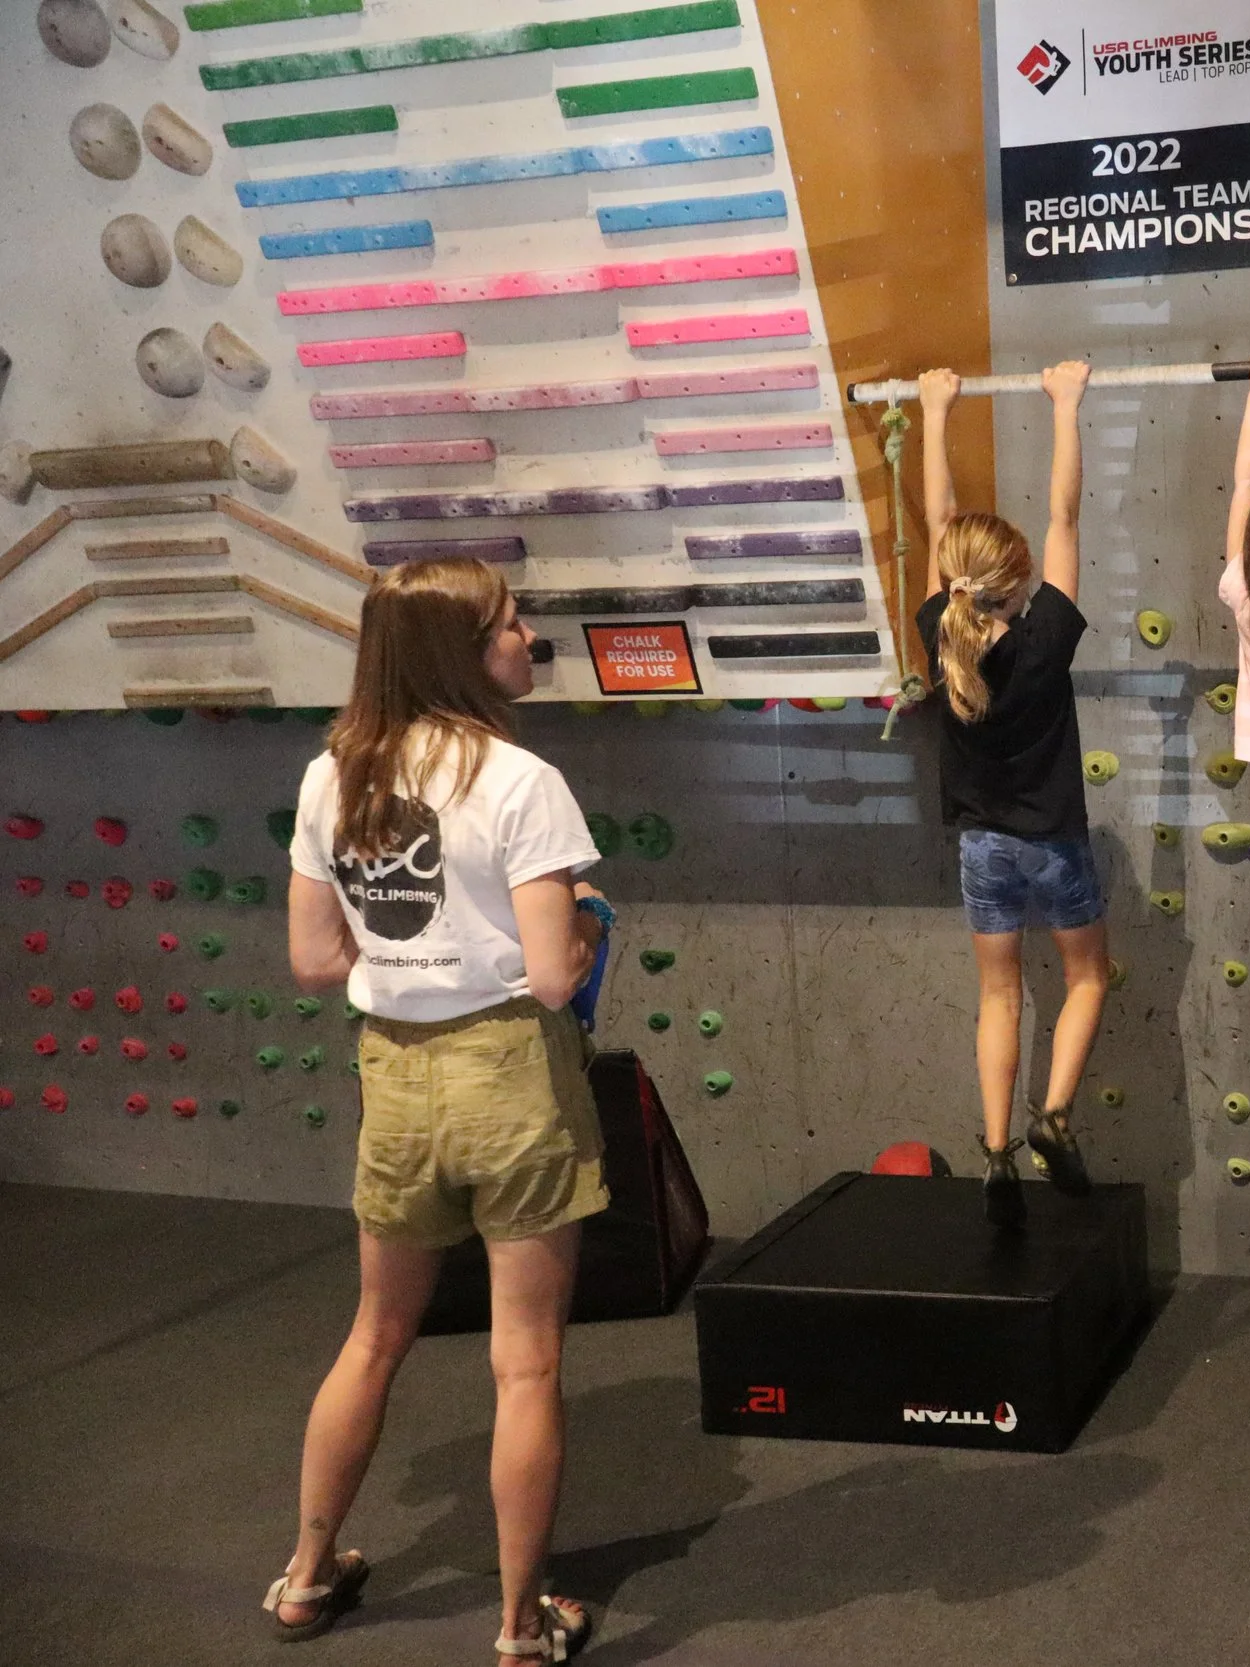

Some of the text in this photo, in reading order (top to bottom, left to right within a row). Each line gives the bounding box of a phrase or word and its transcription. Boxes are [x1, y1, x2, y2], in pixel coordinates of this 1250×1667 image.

[1093, 31, 1218, 55] USA CLIMBING
[1093, 46, 1172, 77] YOUTH
[1159, 69, 1190, 84] LEAD
[1201, 65, 1225, 79] TOP
[1092, 137, 1182, 177] 2022
[1025, 188, 1166, 222] REGIONAL
[612, 635, 662, 648] CHALK
[606, 649, 677, 664] REQUIRED
[616, 664, 676, 678] FOR USE
[366, 888, 438, 904] CLIMBING
[903, 1408, 991, 1425] TITAN
